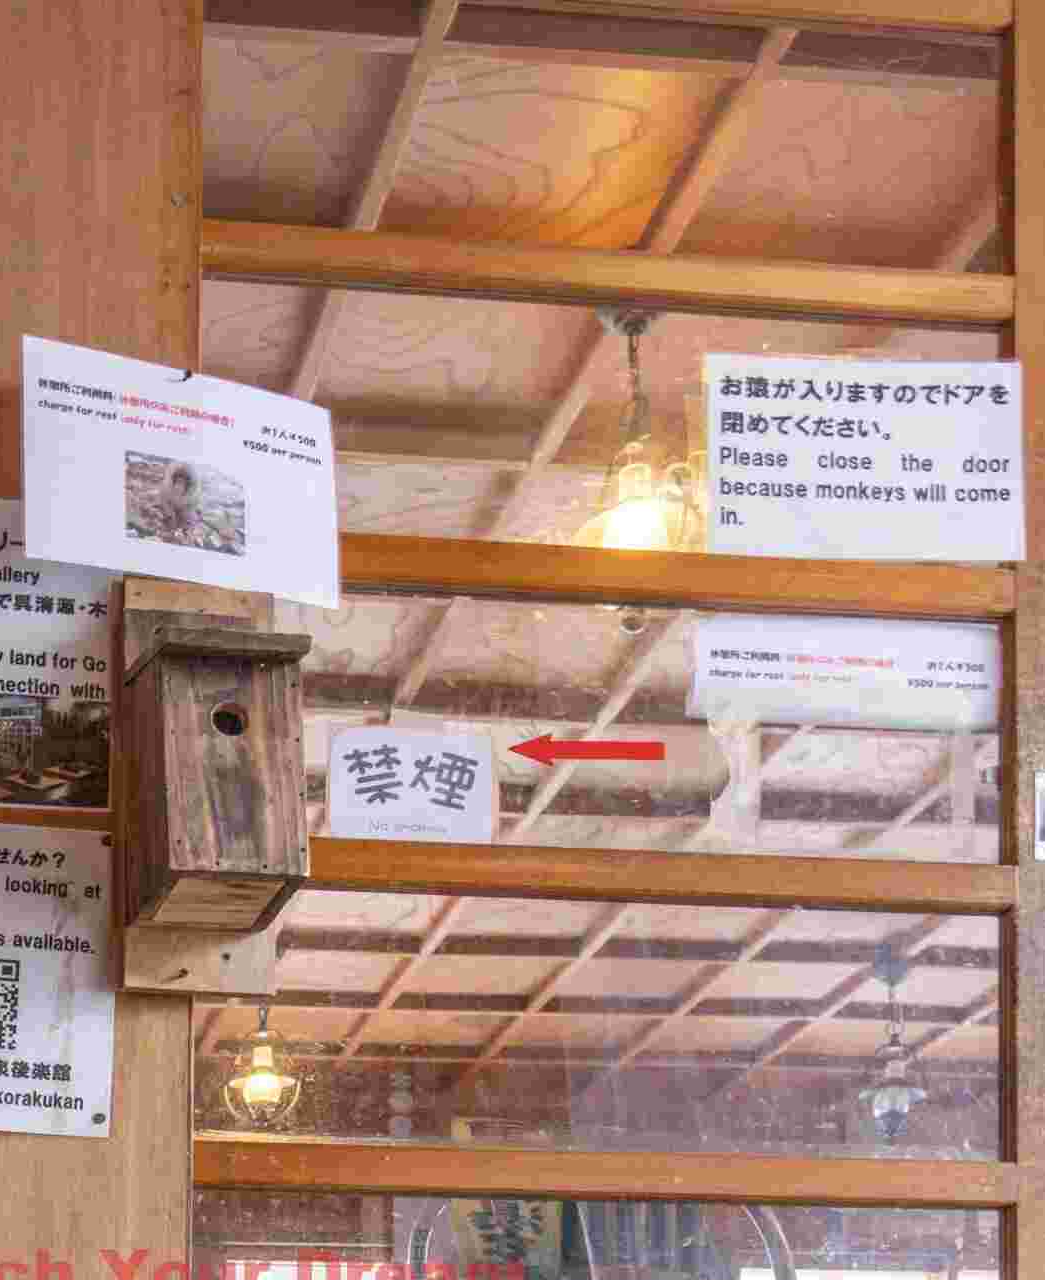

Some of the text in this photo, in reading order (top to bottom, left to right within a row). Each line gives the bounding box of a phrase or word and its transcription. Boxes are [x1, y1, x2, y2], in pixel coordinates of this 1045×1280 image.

[719, 376, 1010, 405] お猿が入りますのでドアを
[720, 412, 891, 440] 閉めてください。
[719, 446, 1010, 473] Please close the door
[719, 478, 1010, 502] because monkeys will come
[719, 506, 744, 525] in.
[10, 649, 46, 668] land
[53, 652, 77, 670] for
[83, 656, 106, 673] Go
[71, 682, 106, 699] with
[343, 744, 479, 810] 禁煙
[5, 876, 68, 898] looking
[84, 883, 102, 899] at
[13, 932, 94, 954] available.
